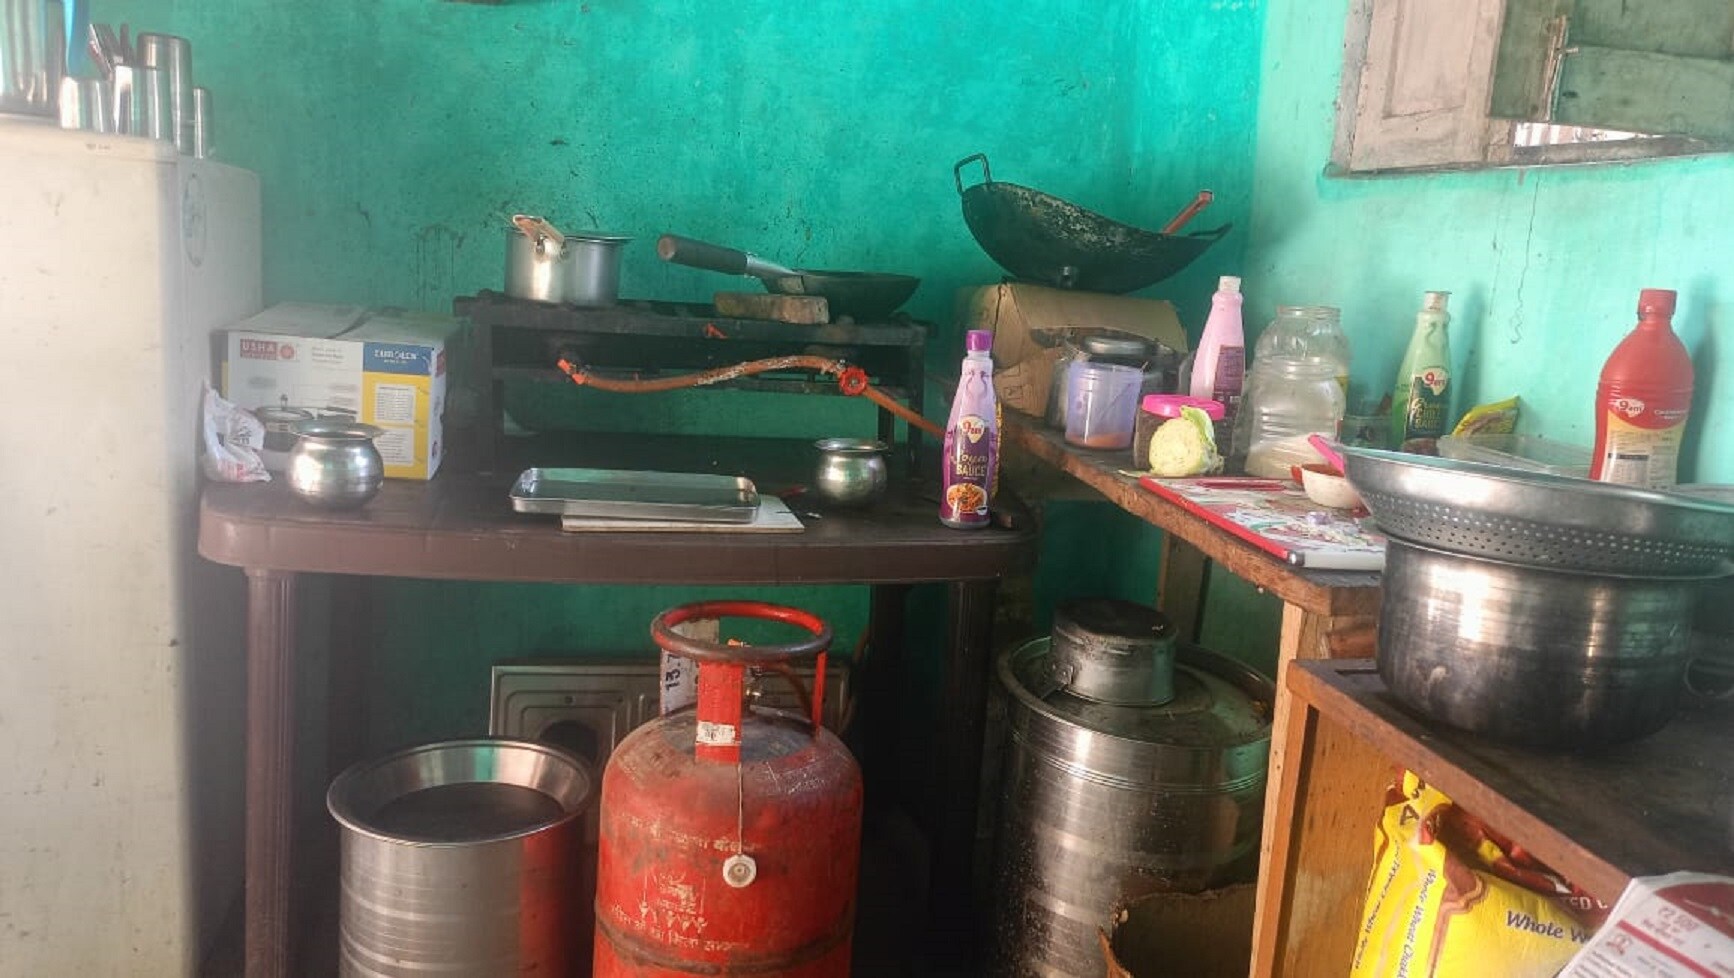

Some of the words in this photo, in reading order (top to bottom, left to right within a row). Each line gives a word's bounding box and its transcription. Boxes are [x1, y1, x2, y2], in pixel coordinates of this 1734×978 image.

[241, 339, 275, 352] USHA
[1619, 400, 1643, 412] 9am
[956, 464, 985, 476] SAUCE
[1506, 910, 1564, 939] Whole
